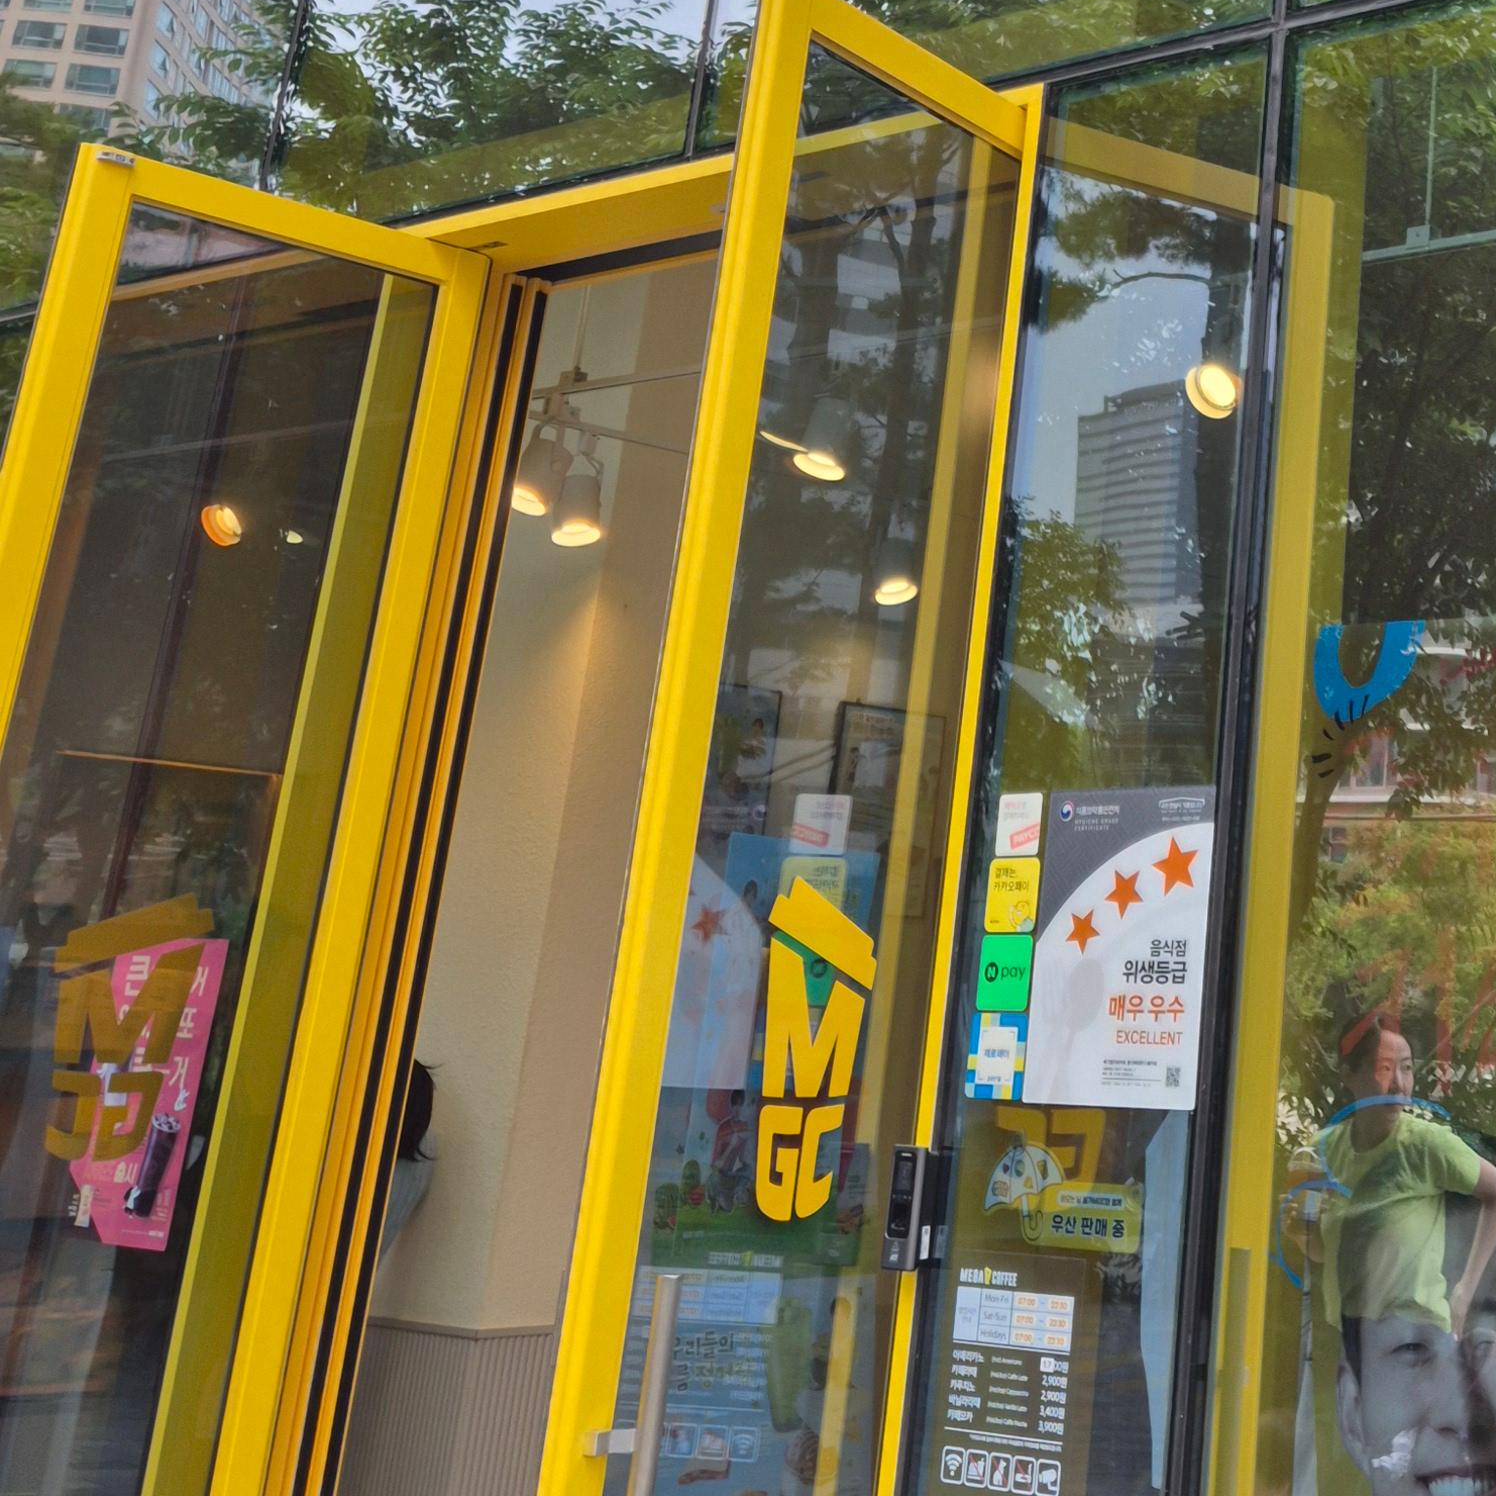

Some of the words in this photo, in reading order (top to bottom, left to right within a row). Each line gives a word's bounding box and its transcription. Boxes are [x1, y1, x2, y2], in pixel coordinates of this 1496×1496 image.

[1149, 939, 1188, 958] 음식점
[1122, 960, 1188, 985] 위생등급
[1108, 994, 1145, 1023] 매우
[1147, 995, 1185, 1023] 우수
[1116, 1029, 1184, 1046] EXCELLENT
[1051, 1214, 1077, 1235] 우산
[1080, 1216, 1108, 1238] 판매
[1112, 1219, 1125, 1239] 중
[960, 1268, 984, 1283] MEGA
[991, 1270, 1018, 1287] COFFEE
